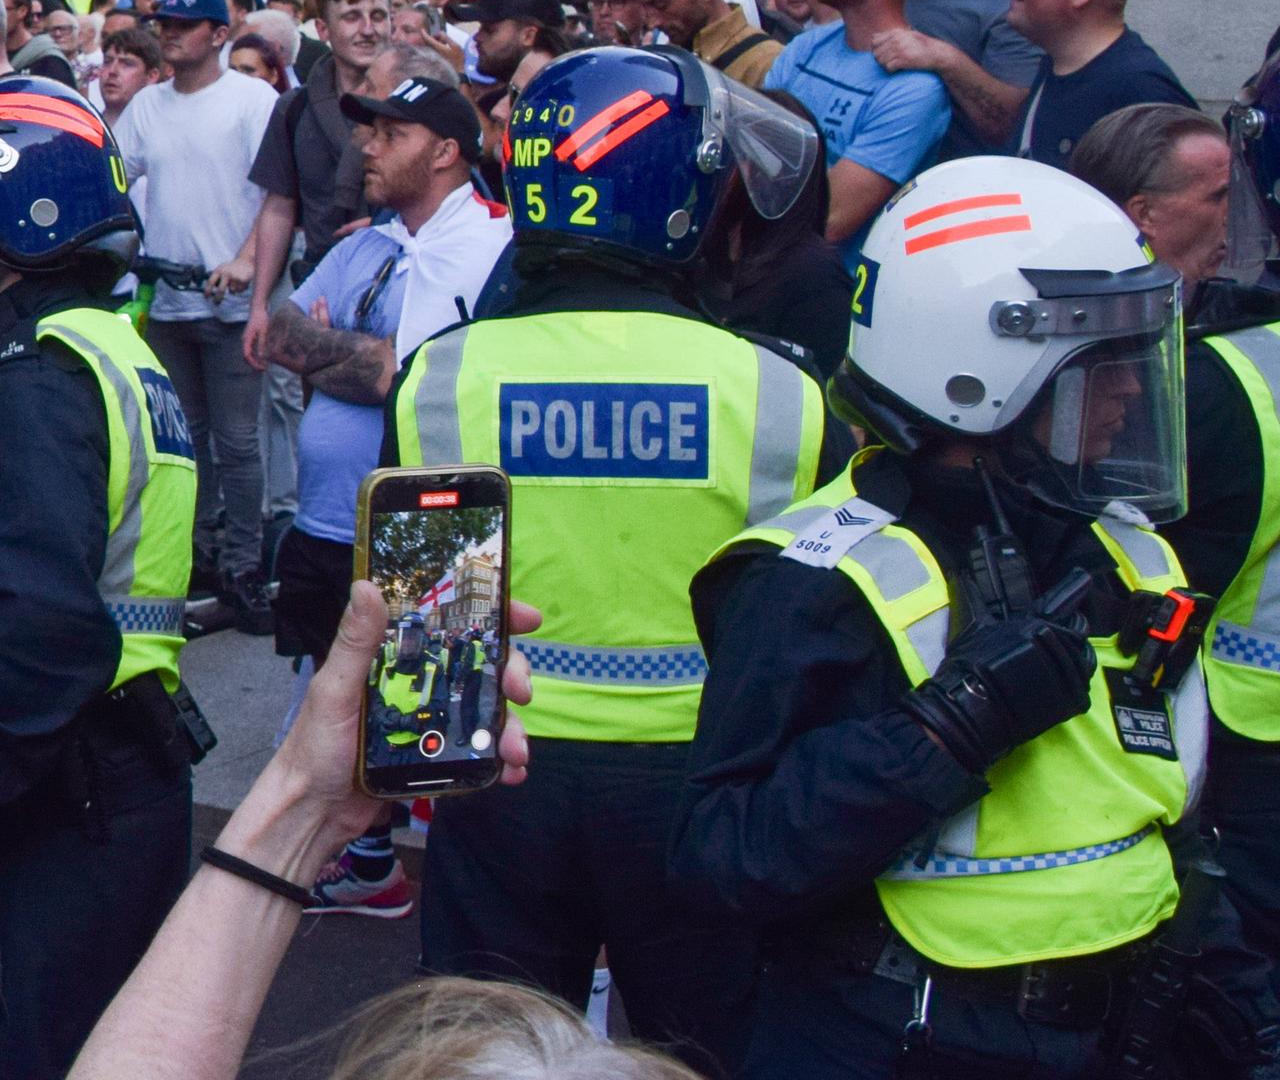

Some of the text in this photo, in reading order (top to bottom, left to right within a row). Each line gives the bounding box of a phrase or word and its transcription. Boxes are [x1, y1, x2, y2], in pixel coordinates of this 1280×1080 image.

[512, 104, 575, 127] 2940
[514, 138, 551, 167] MP
[110, 155, 127, 194] U
[852, 263, 868, 315] 2
[510, 400, 697, 461] POLICE
[796, 539, 832, 554] 5009
